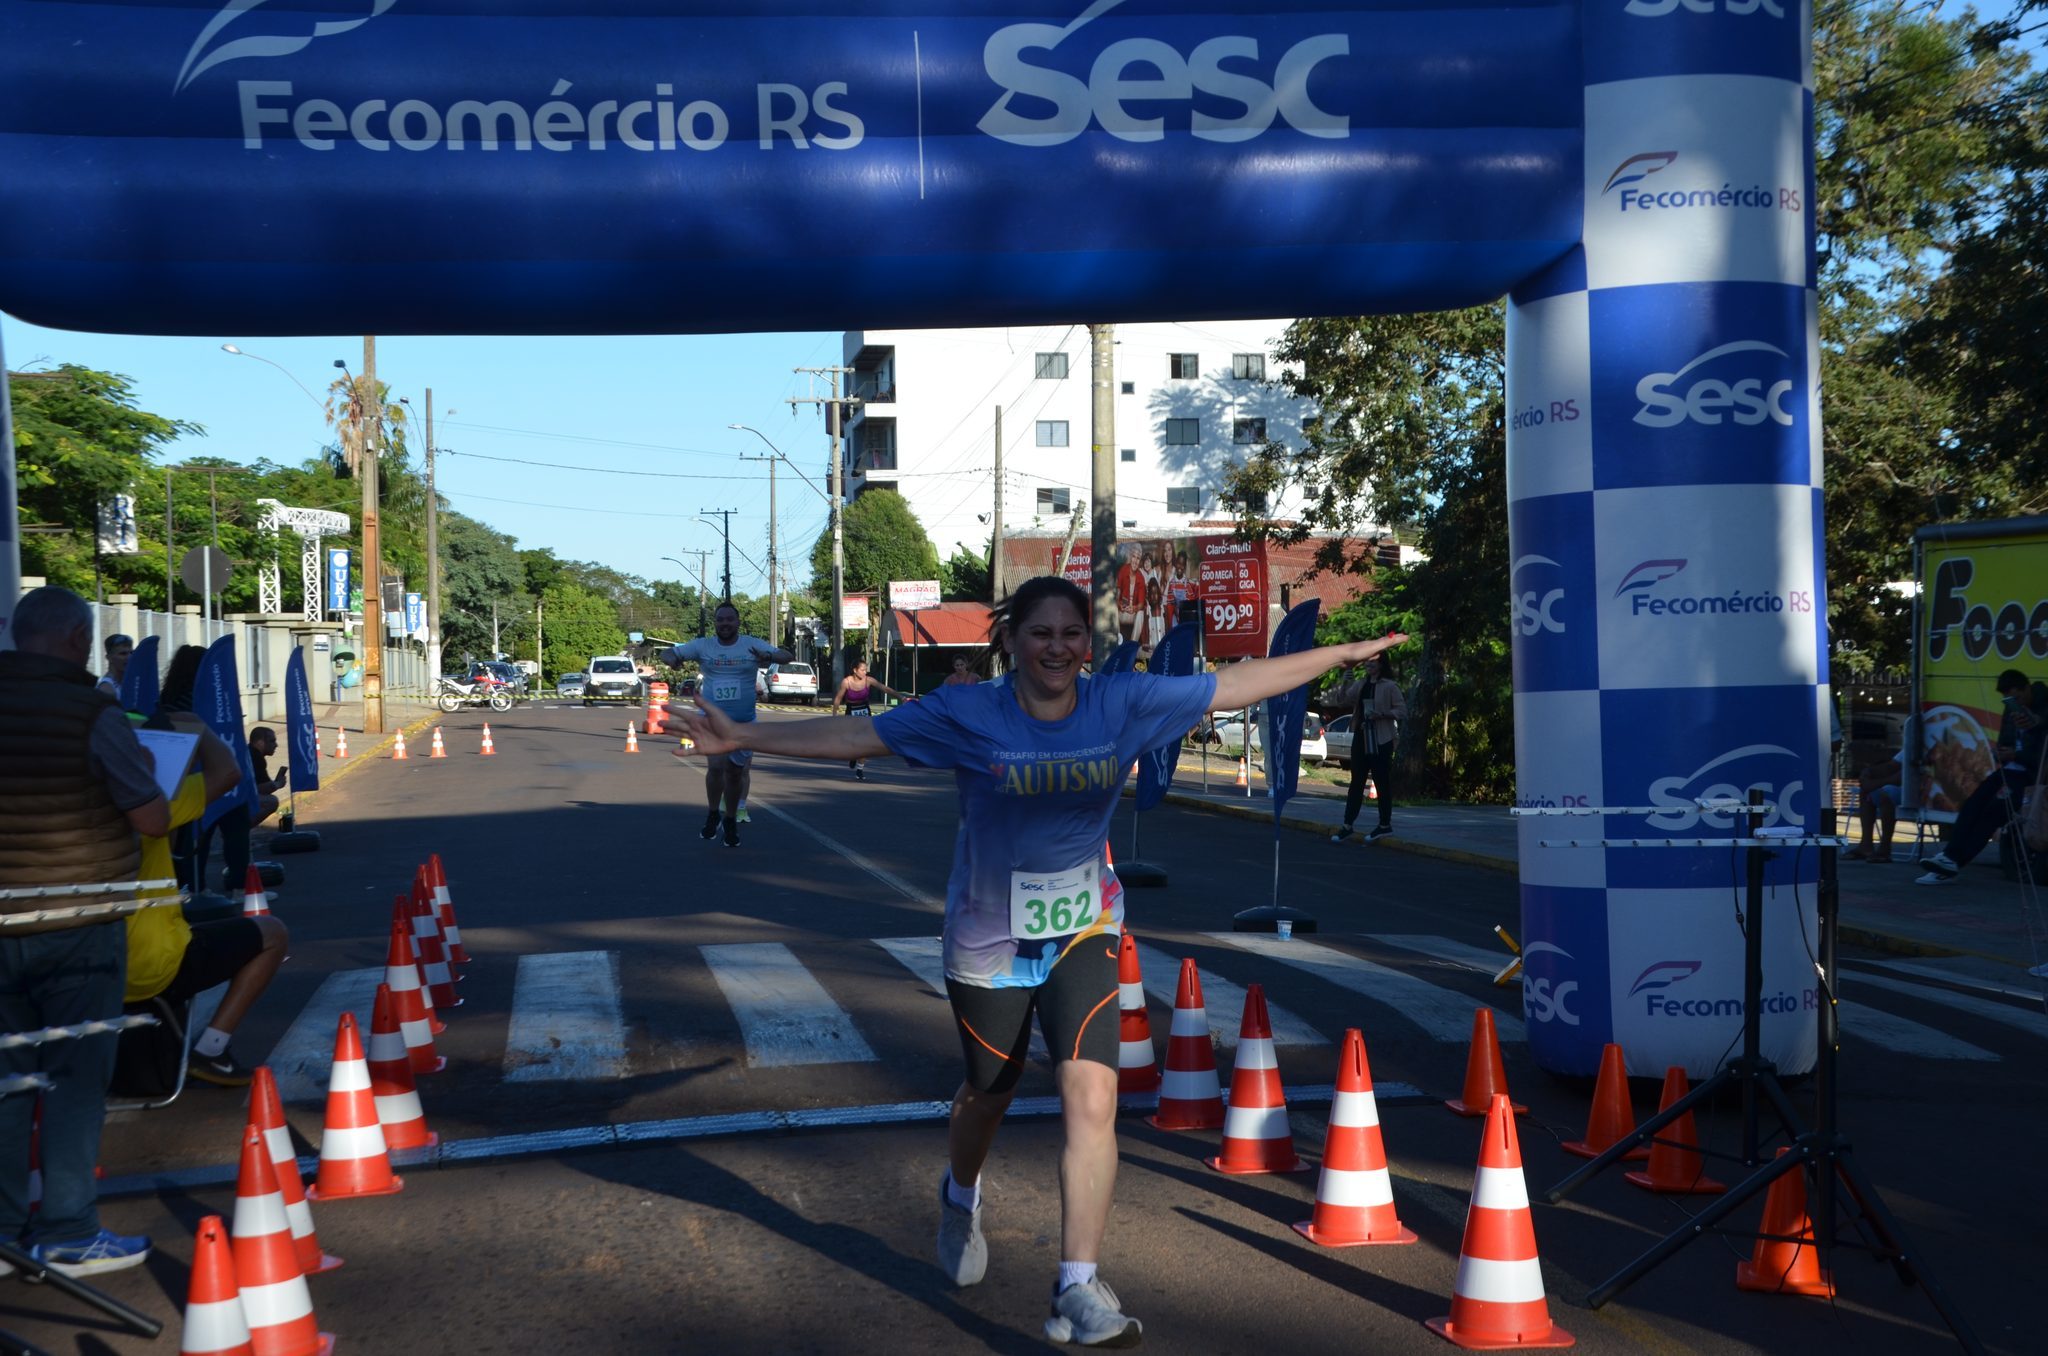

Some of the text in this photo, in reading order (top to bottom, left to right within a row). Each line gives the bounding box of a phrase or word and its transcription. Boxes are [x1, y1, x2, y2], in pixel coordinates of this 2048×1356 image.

[976, 22, 1350, 147] Sesc
[237, 79, 865, 152] Fecomércio RS
[1621, 184, 1801, 213] Fecomércio RS
[1550, 399, 1581, 424] RS
[1632, 372, 1794, 429] Sesc
[1202, 570, 1234, 581] 600 MEGA
[1239, 569, 1249, 579] 60
[1239, 580, 1256, 590] GIGA
[334, 568, 348, 608] URI
[1632, 590, 1811, 616] Fecomércio RS
[409, 605, 418, 632] URI
[1213, 604, 1253, 631] 99,90
[716, 687, 737, 699] 337
[999, 751, 1036, 760] DESAFIO
[1039, 751, 1051, 760] EM
[1004, 754, 1120, 796] AUTISMO
[1020, 881, 1045, 891] Sesc
[1024, 890, 1093, 935] 362
[1646, 991, 1797, 1017] Fecomrcio
